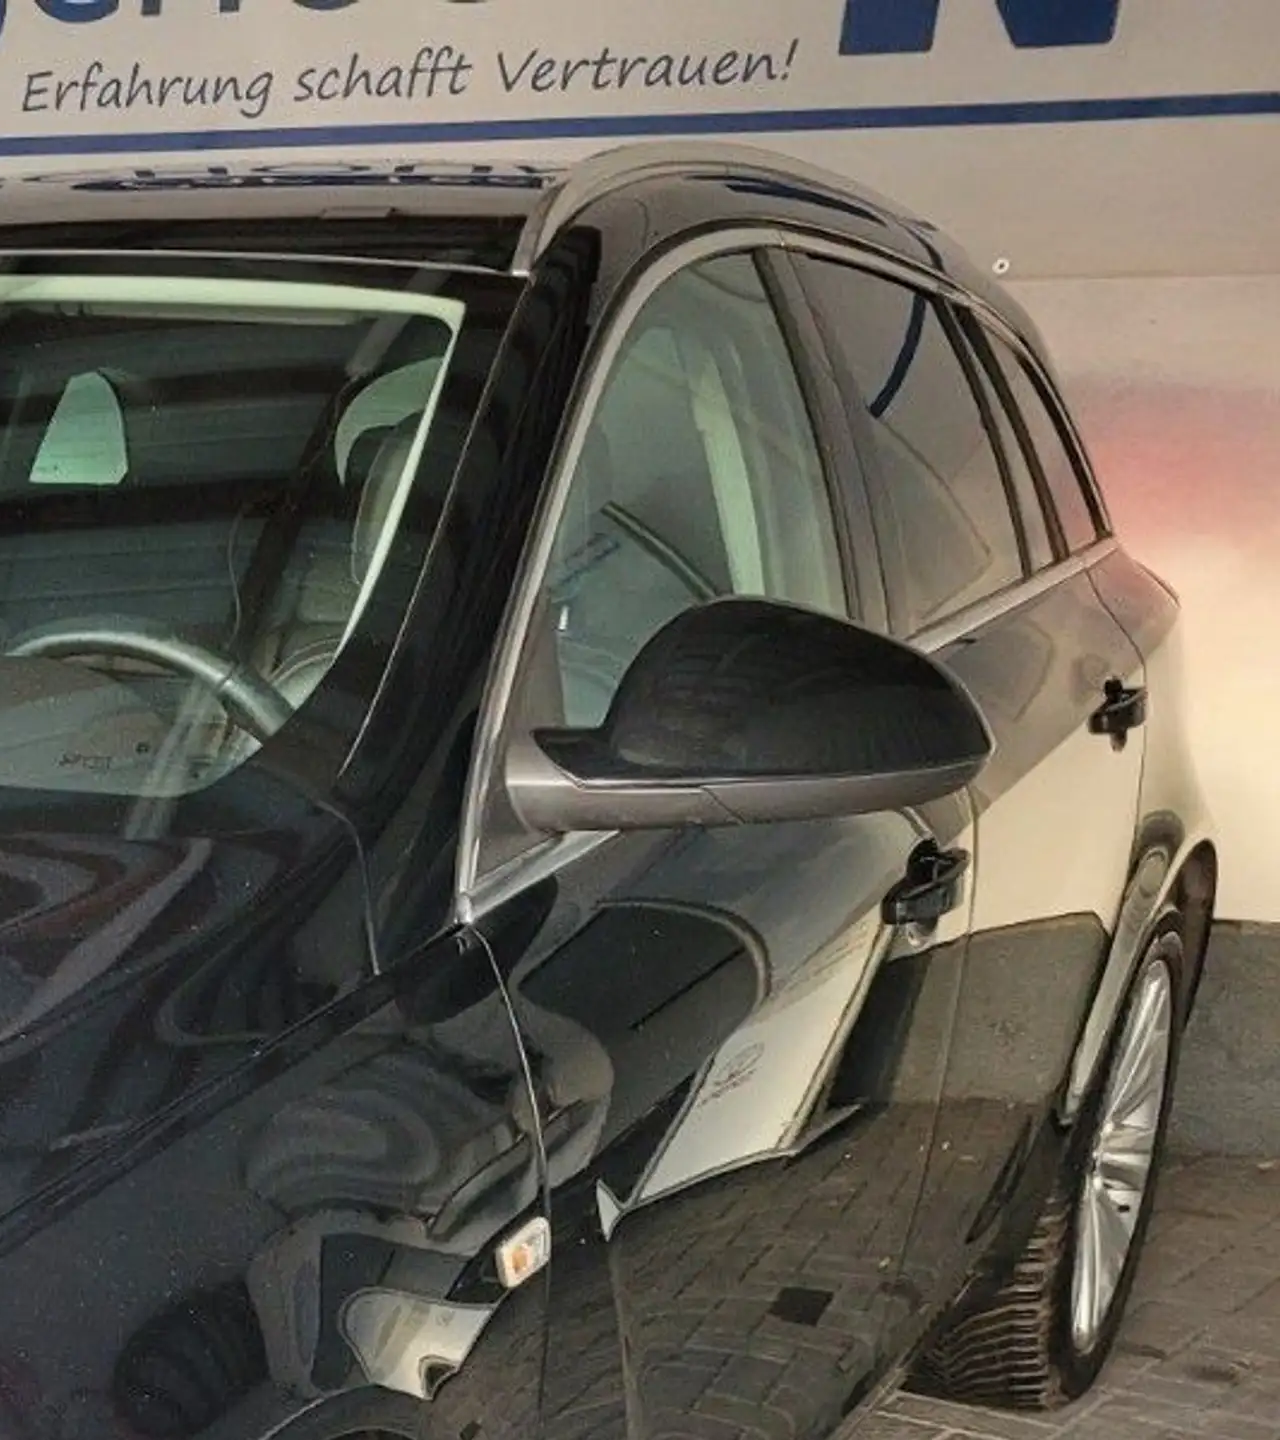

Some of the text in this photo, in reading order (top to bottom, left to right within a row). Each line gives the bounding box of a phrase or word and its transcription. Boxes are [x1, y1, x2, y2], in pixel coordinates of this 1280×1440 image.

[20, 39, 800, 119] Erfahrung schafft Vertrauen!
